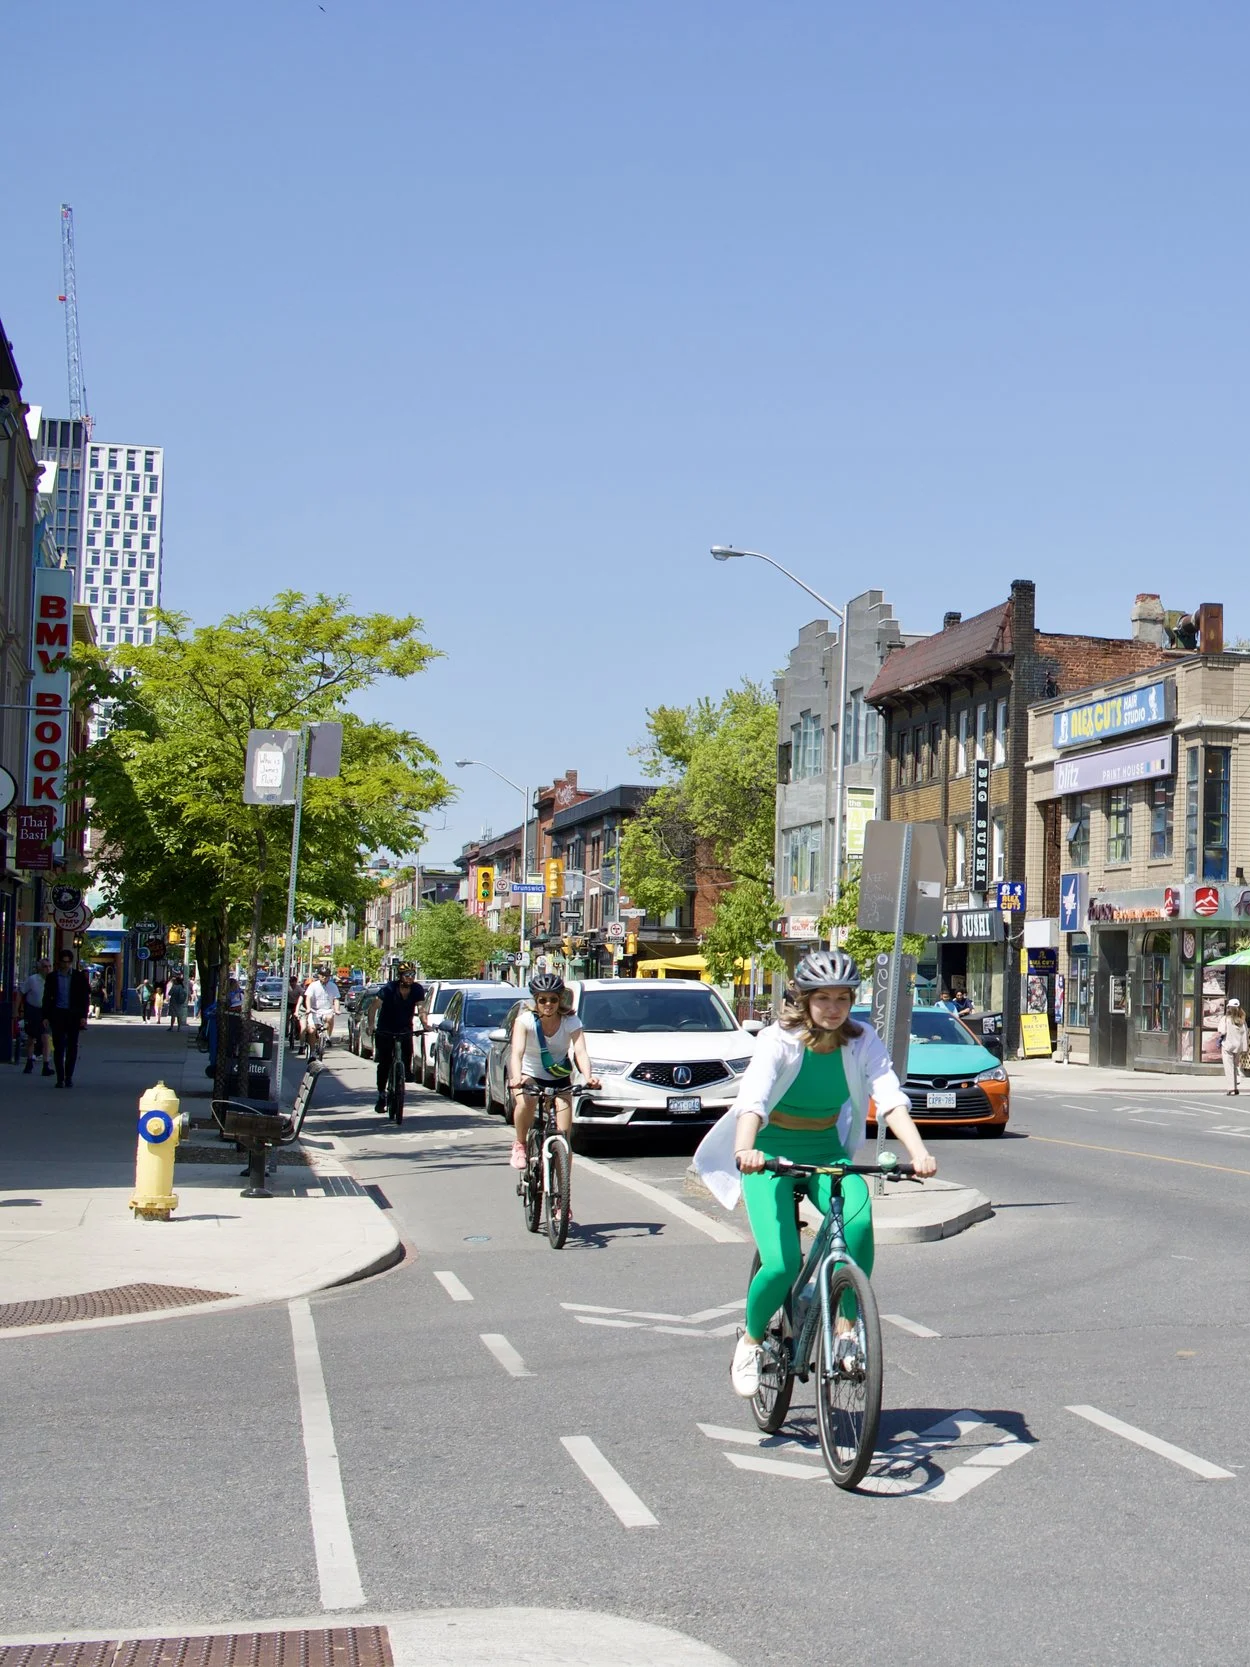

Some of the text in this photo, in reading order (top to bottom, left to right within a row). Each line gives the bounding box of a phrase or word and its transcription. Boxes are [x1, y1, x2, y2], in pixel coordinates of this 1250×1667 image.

[1123, 694, 1138, 710] HAIR
[1070, 698, 1123, 738] ALEX CUTS
[1123, 707, 1146, 726] STUDIO
[33, 693, 63, 827] BOOK
[1057, 762, 1145, 790] blitz PRINT HOUSE
[848, 800, 861, 808] the
[20, 815, 48, 827] Thai
[976, 767, 988, 882] BIG SUSHI
[20, 829, 48, 840] Basil
[1000, 902, 1021, 911] CUTS
[1001, 895, 1019, 904] ALEX
[962, 913, 990, 937] SUSHI
[247, 1064, 266, 1074] itter
